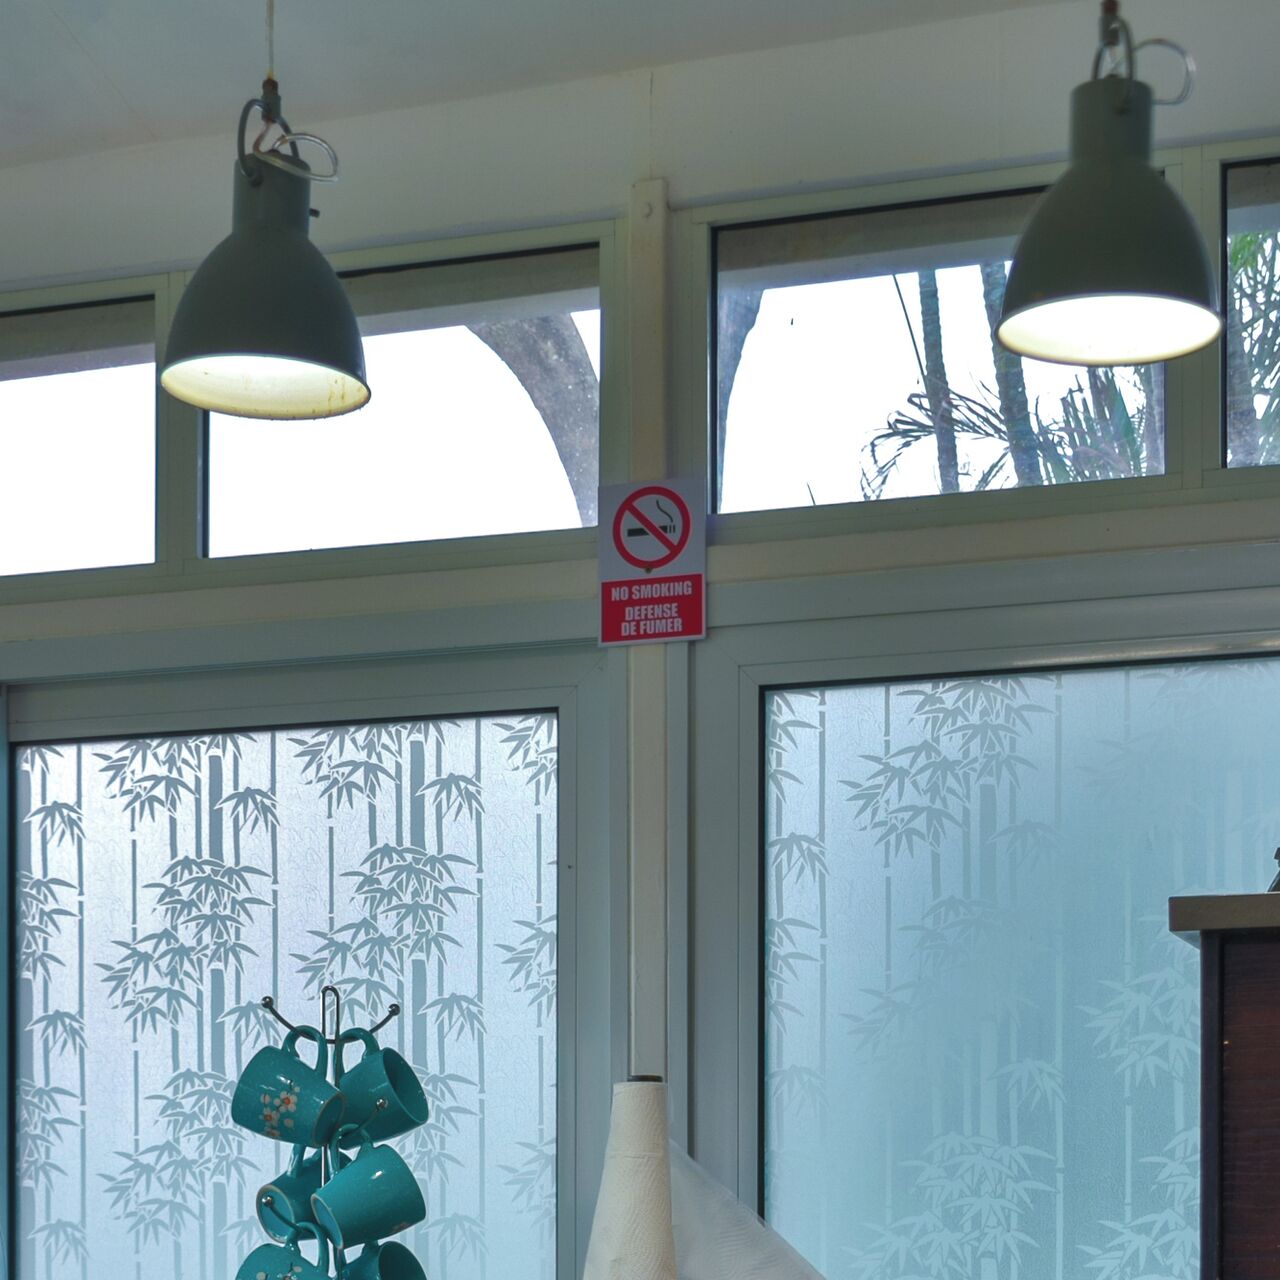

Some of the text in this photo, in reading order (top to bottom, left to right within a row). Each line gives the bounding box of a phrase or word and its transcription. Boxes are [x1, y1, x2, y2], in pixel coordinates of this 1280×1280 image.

[611, 581, 692, 601] NO SMOKING
[625, 603, 678, 621] DEFENSE
[621, 618, 683, 636] DE FUMER
